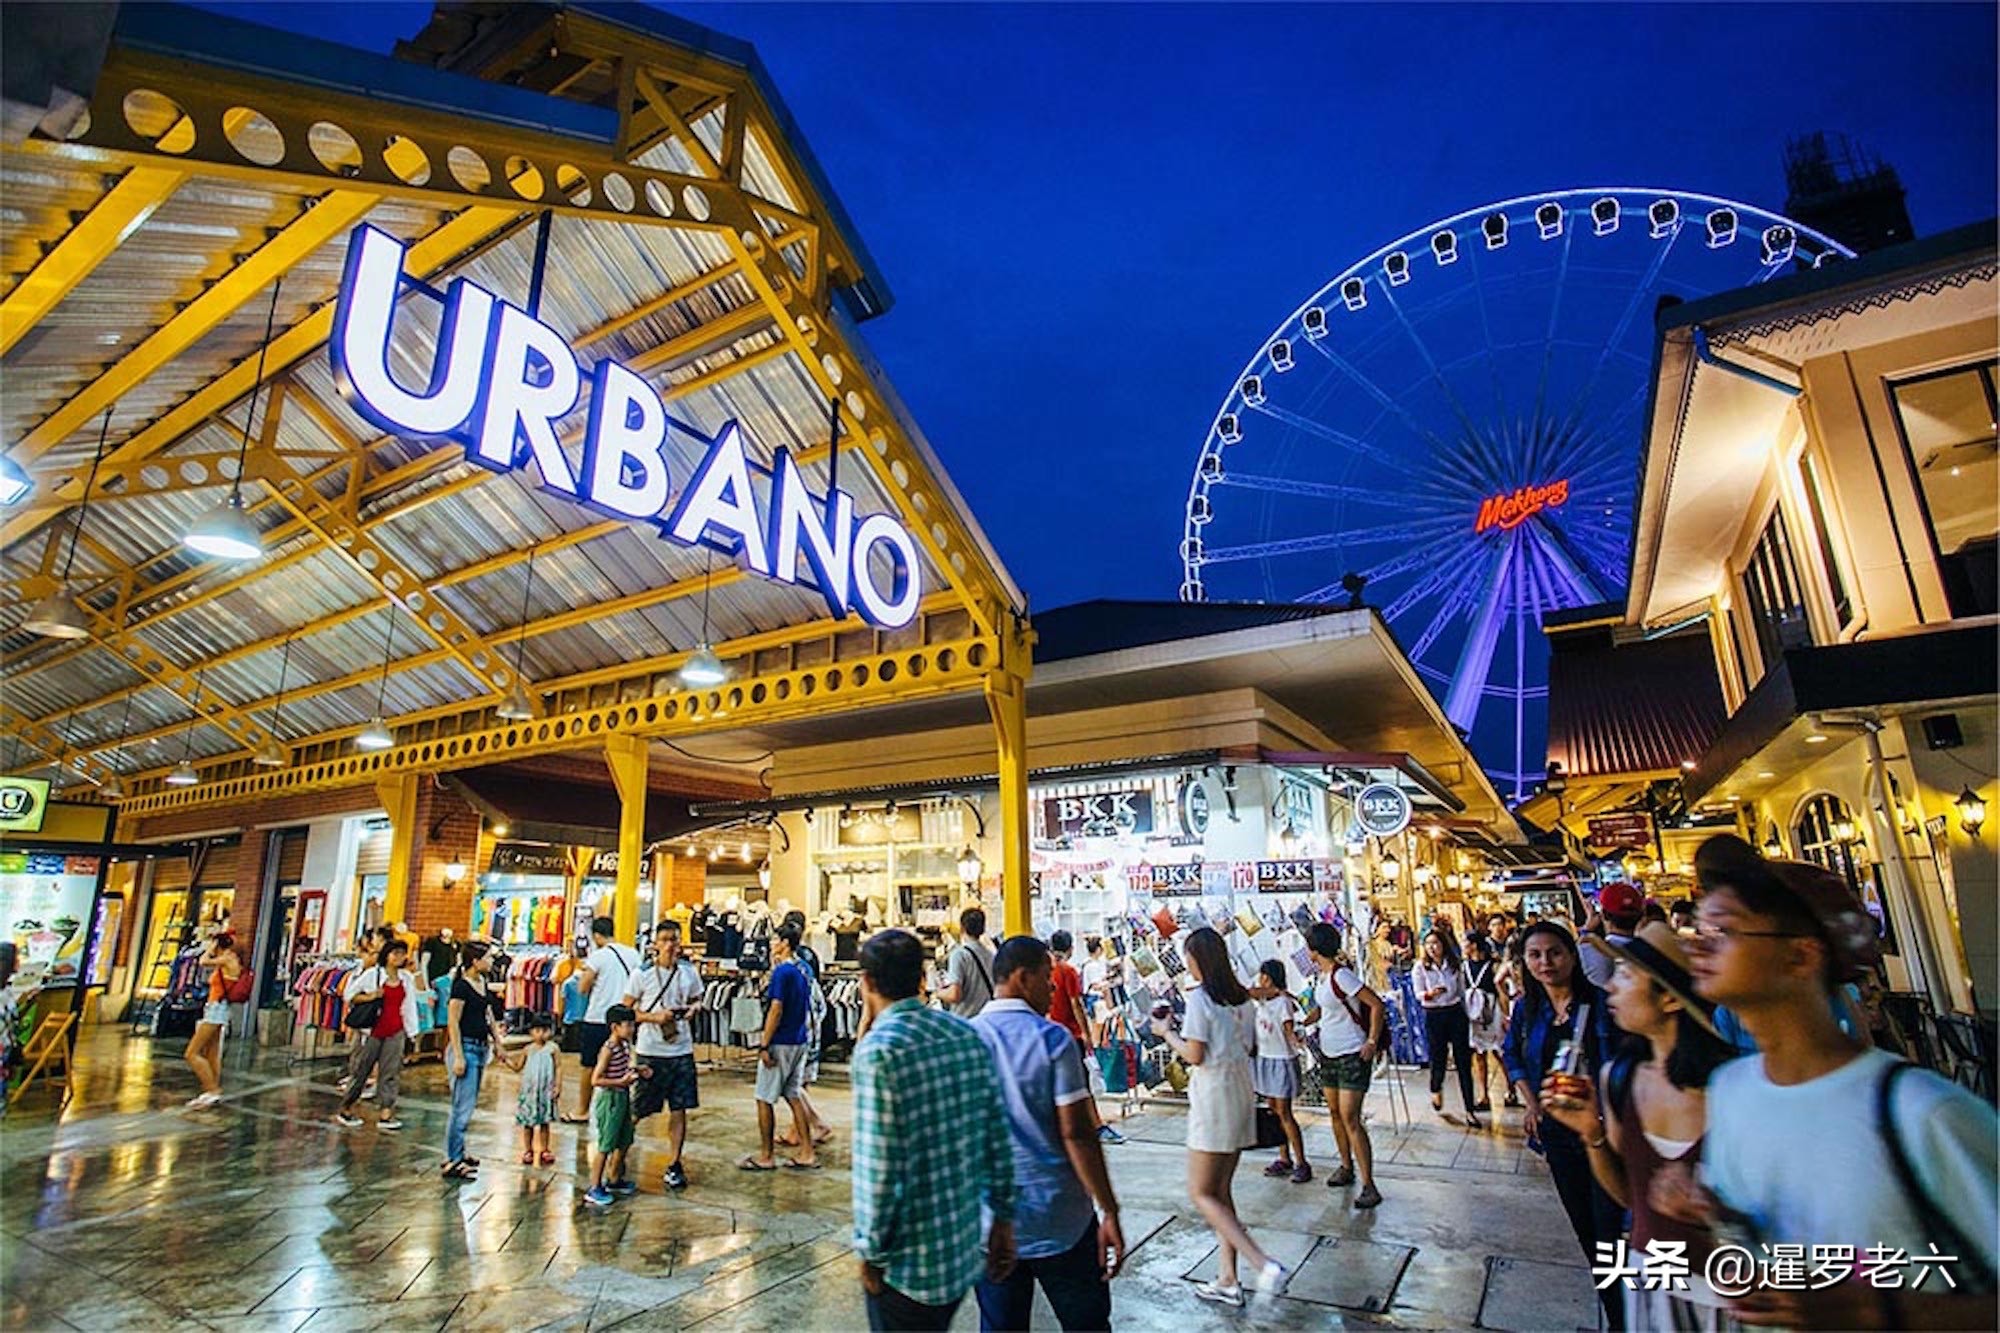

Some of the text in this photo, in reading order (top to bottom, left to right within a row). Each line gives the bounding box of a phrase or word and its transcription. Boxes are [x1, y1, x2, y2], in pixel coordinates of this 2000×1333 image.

[331, 222, 922, 631] URBANO
[1475, 479, 1569, 534] Mekhong
[1057, 792, 1138, 822] BKK
[1363, 798, 1400, 811] BKK
[1154, 864, 1201, 884] BKK
[1260, 861, 1312, 880] BKK
